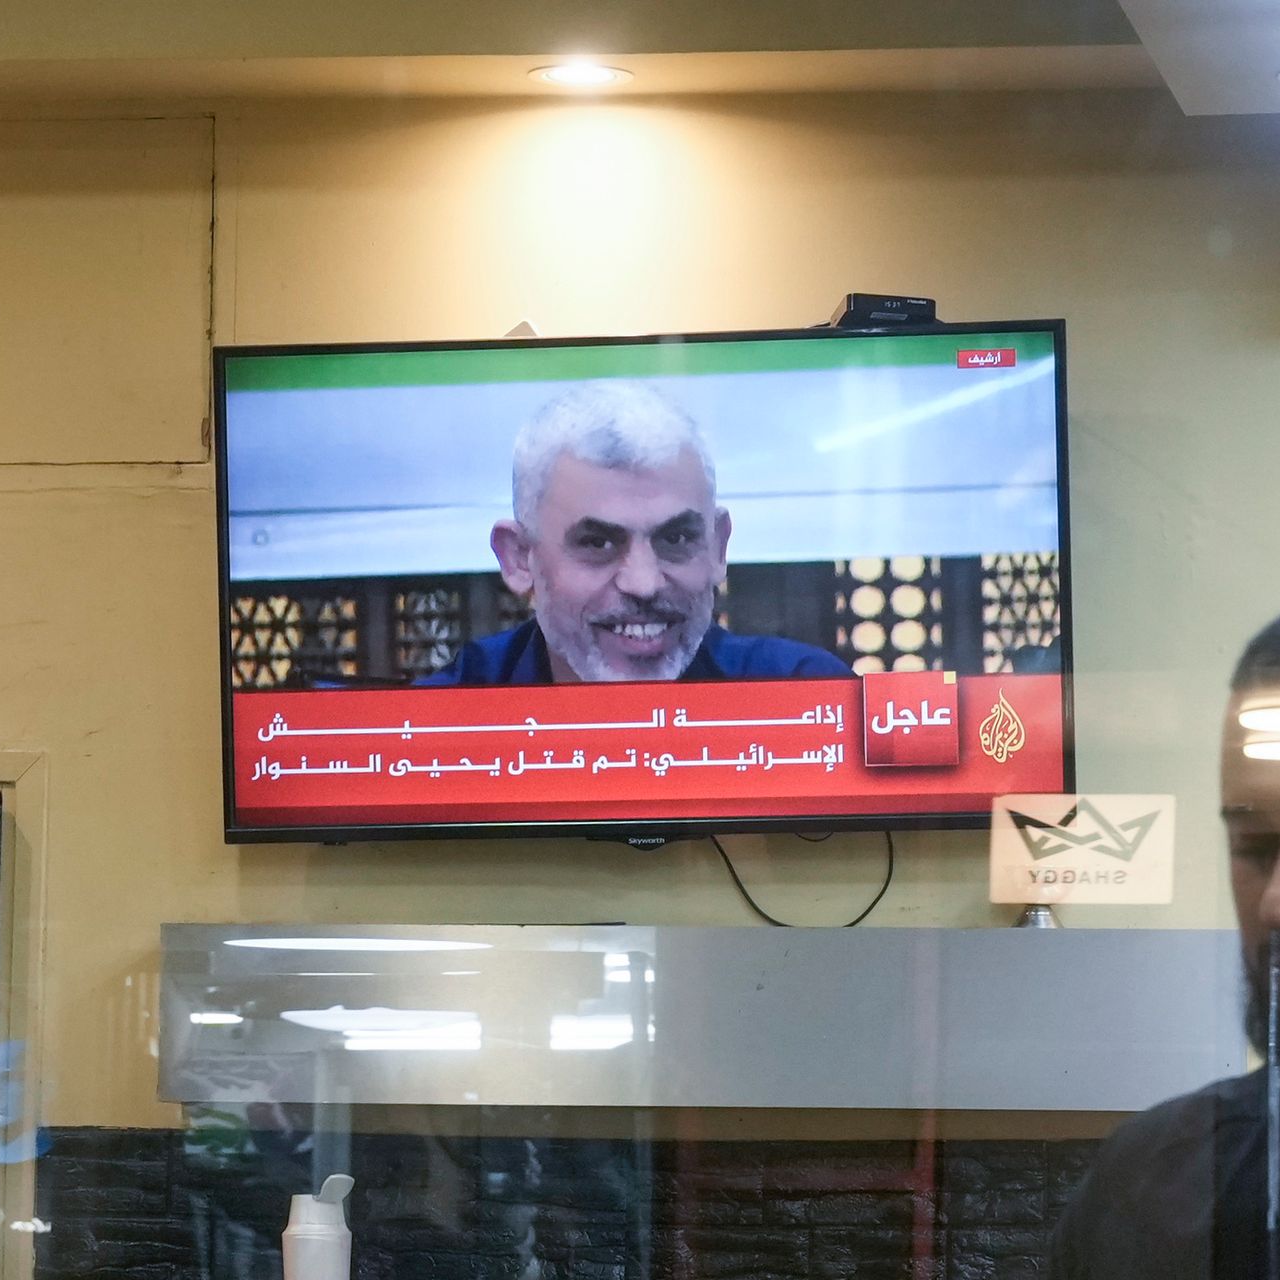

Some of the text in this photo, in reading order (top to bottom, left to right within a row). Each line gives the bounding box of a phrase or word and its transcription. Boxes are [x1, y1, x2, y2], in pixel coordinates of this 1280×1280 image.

[257, 704, 844, 742] إذاعة الجيش
[870, 699, 951, 735] عاجل
[251, 742, 844, 781] الإسرائيلي: تم قتل يحيى السنوار
[628, 837, 665, 845] Skyworth
